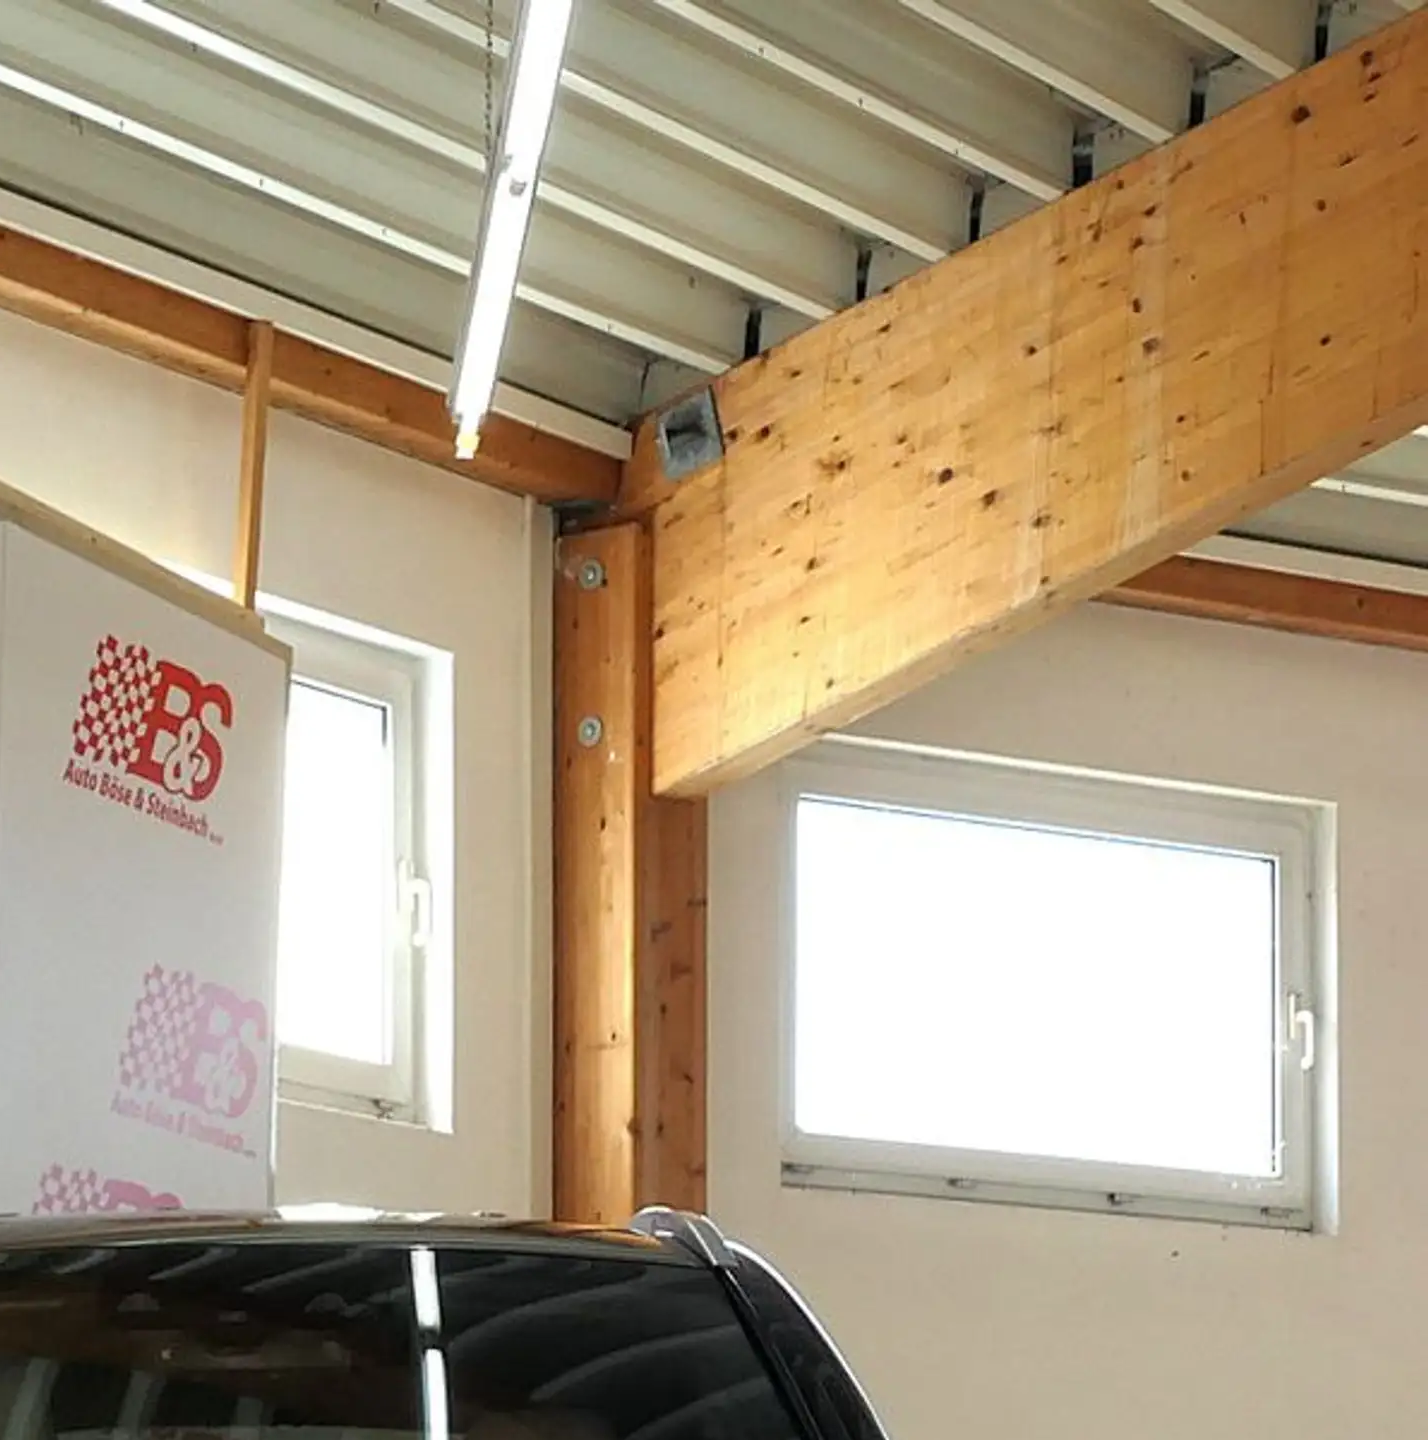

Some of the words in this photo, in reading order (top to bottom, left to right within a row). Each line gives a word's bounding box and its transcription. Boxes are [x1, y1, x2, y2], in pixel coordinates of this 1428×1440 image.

[63, 757, 98, 791] Auto
[98, 771, 134, 806] Böse
[134, 787, 145, 811] &
